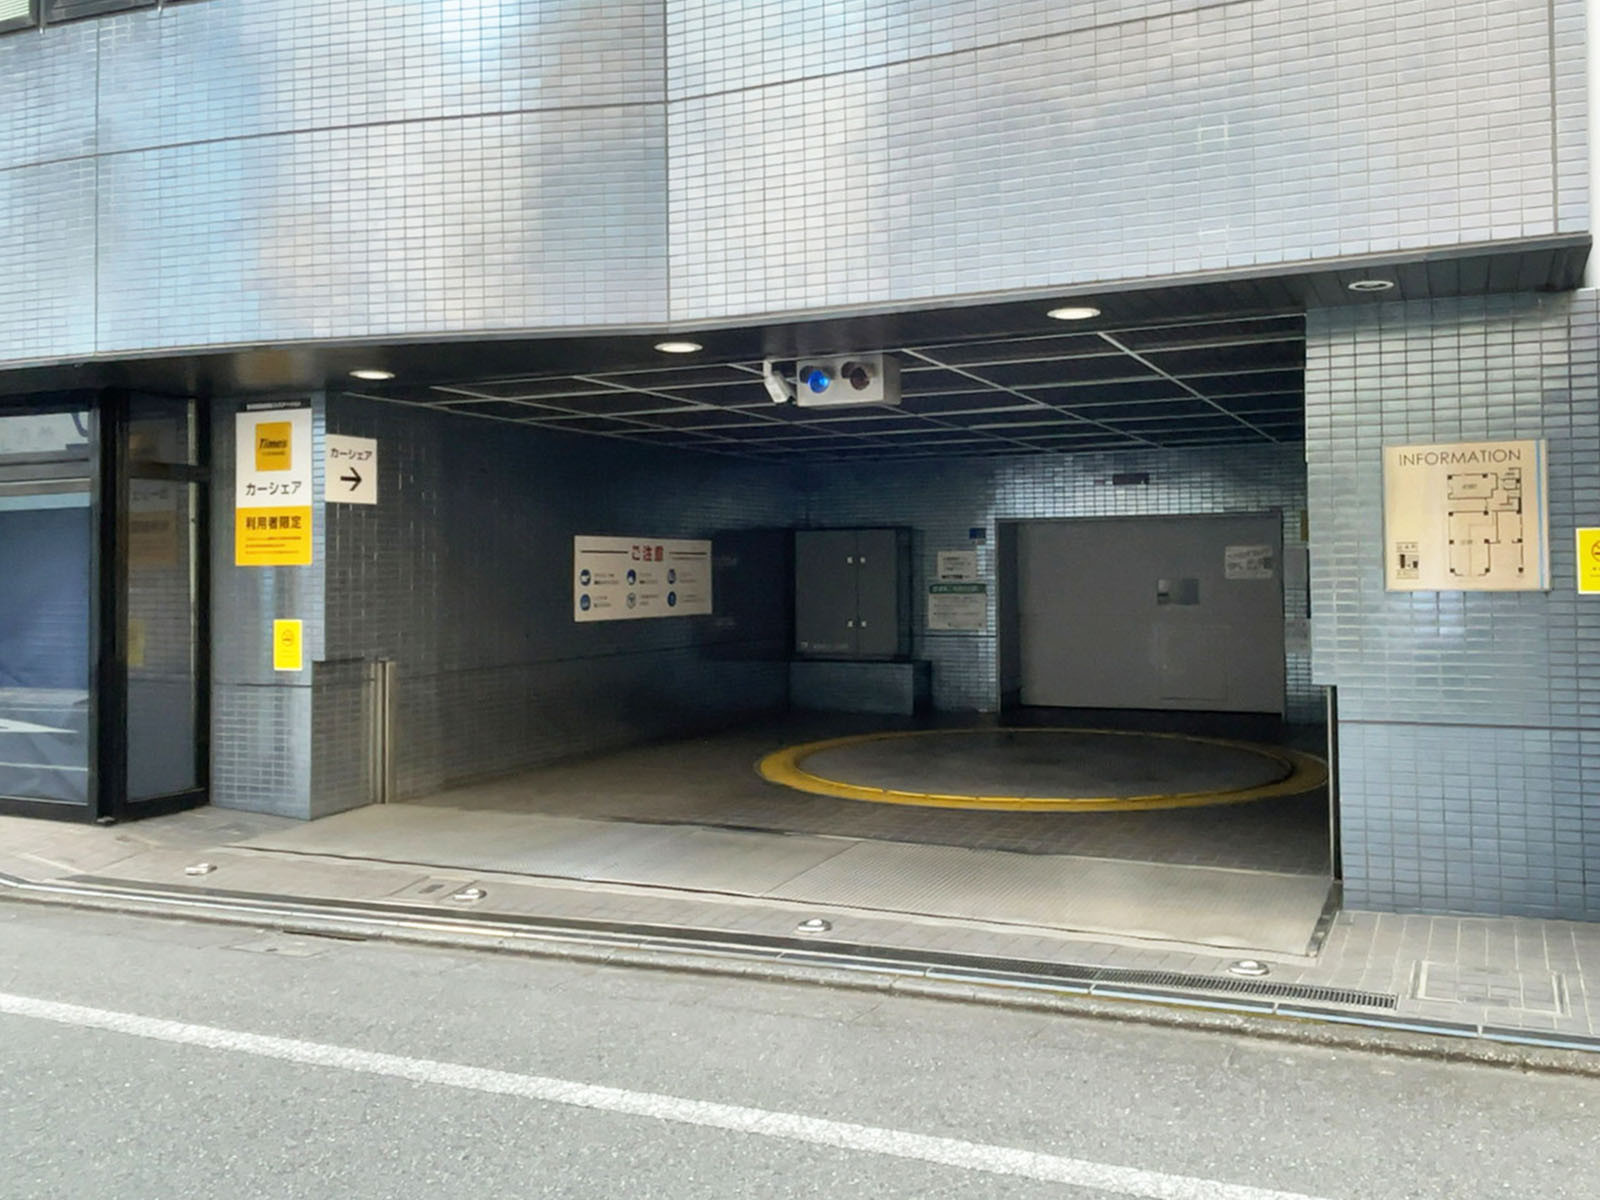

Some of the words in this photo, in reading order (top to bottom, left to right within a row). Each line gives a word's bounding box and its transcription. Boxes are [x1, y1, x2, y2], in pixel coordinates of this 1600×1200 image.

[330, 447, 373, 461] カーシェア
[1399, 449, 1521, 466] INFORMATION
[246, 481, 302, 496] カーシェア
[246, 514, 302, 530] 利用者限定
